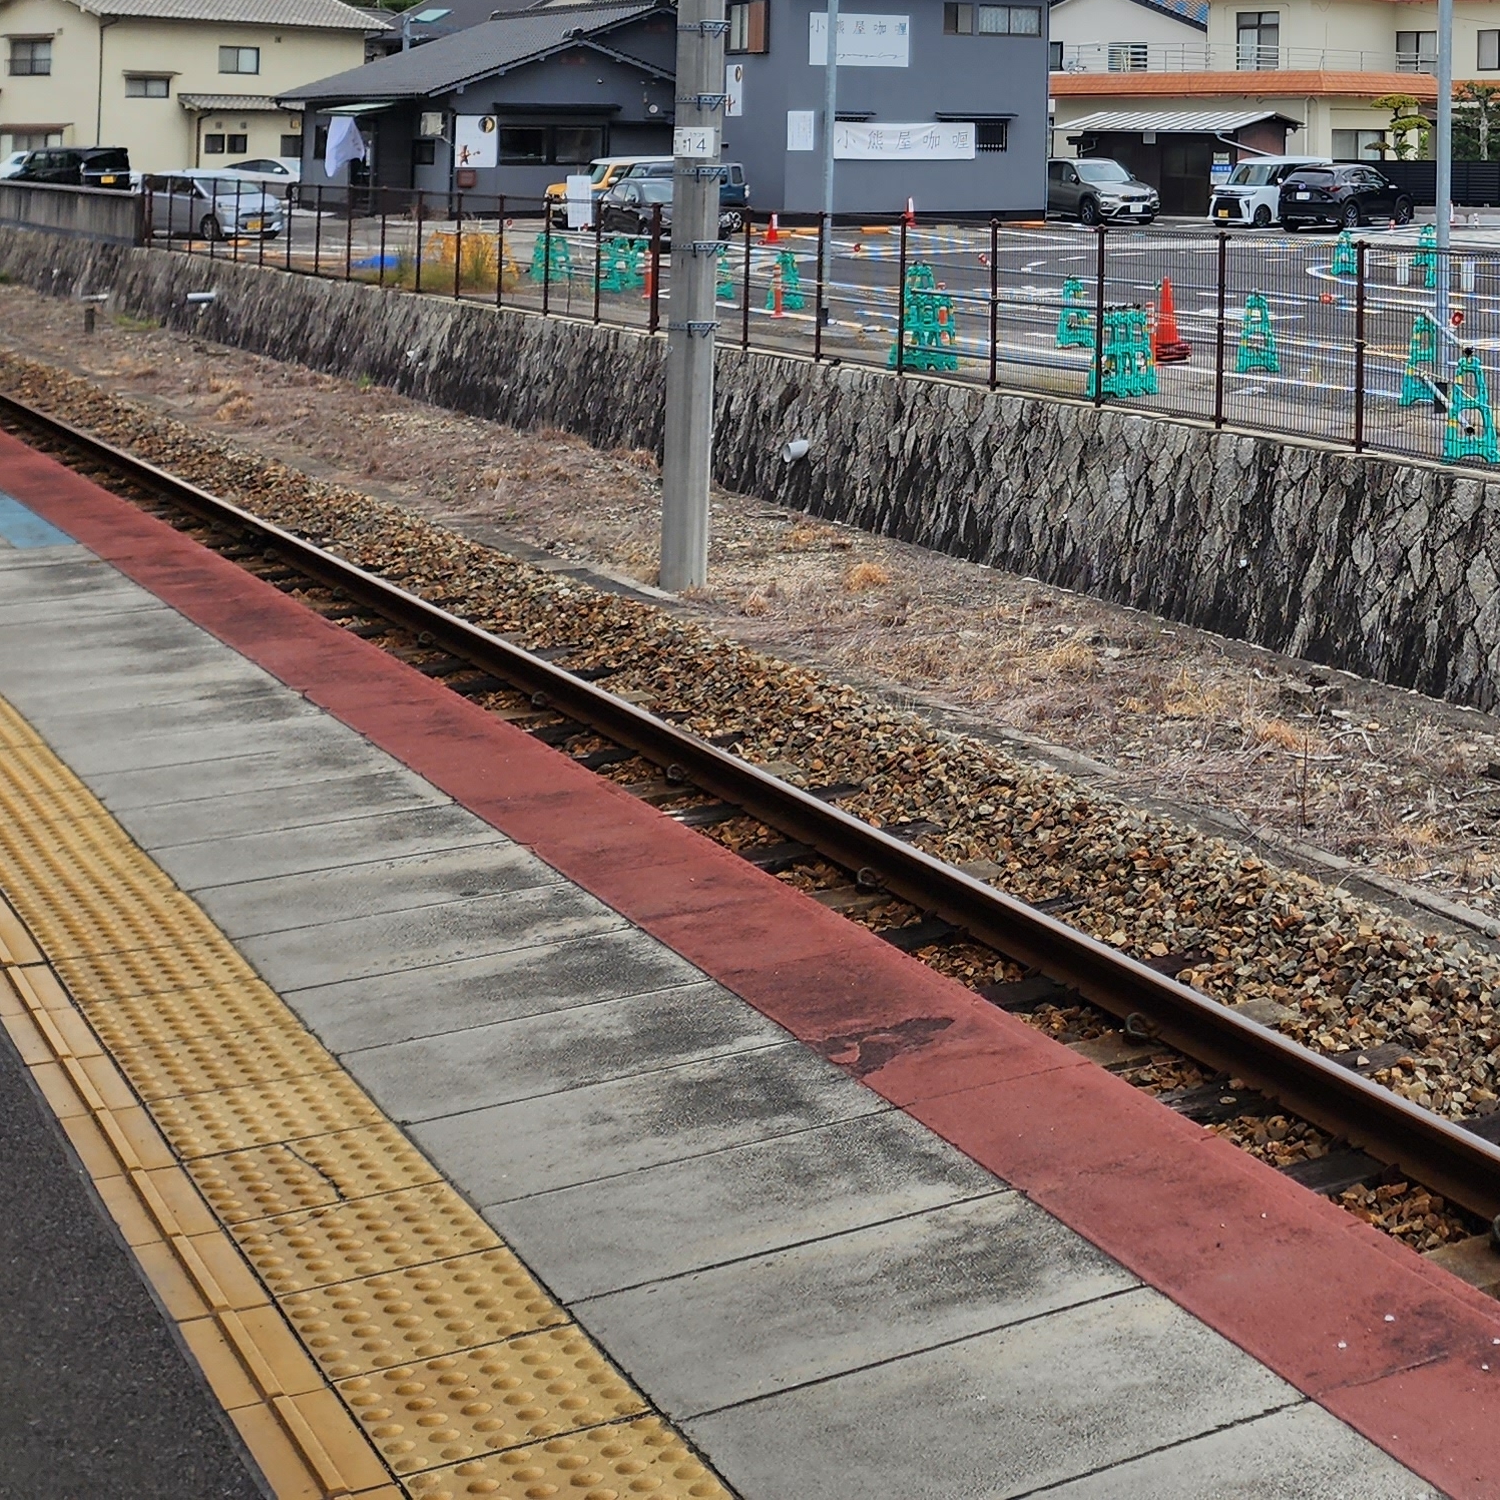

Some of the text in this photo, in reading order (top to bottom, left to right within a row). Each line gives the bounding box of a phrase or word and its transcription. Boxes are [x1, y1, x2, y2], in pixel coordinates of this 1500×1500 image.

[837, 129, 969, 150] 小熊屋咖喱
